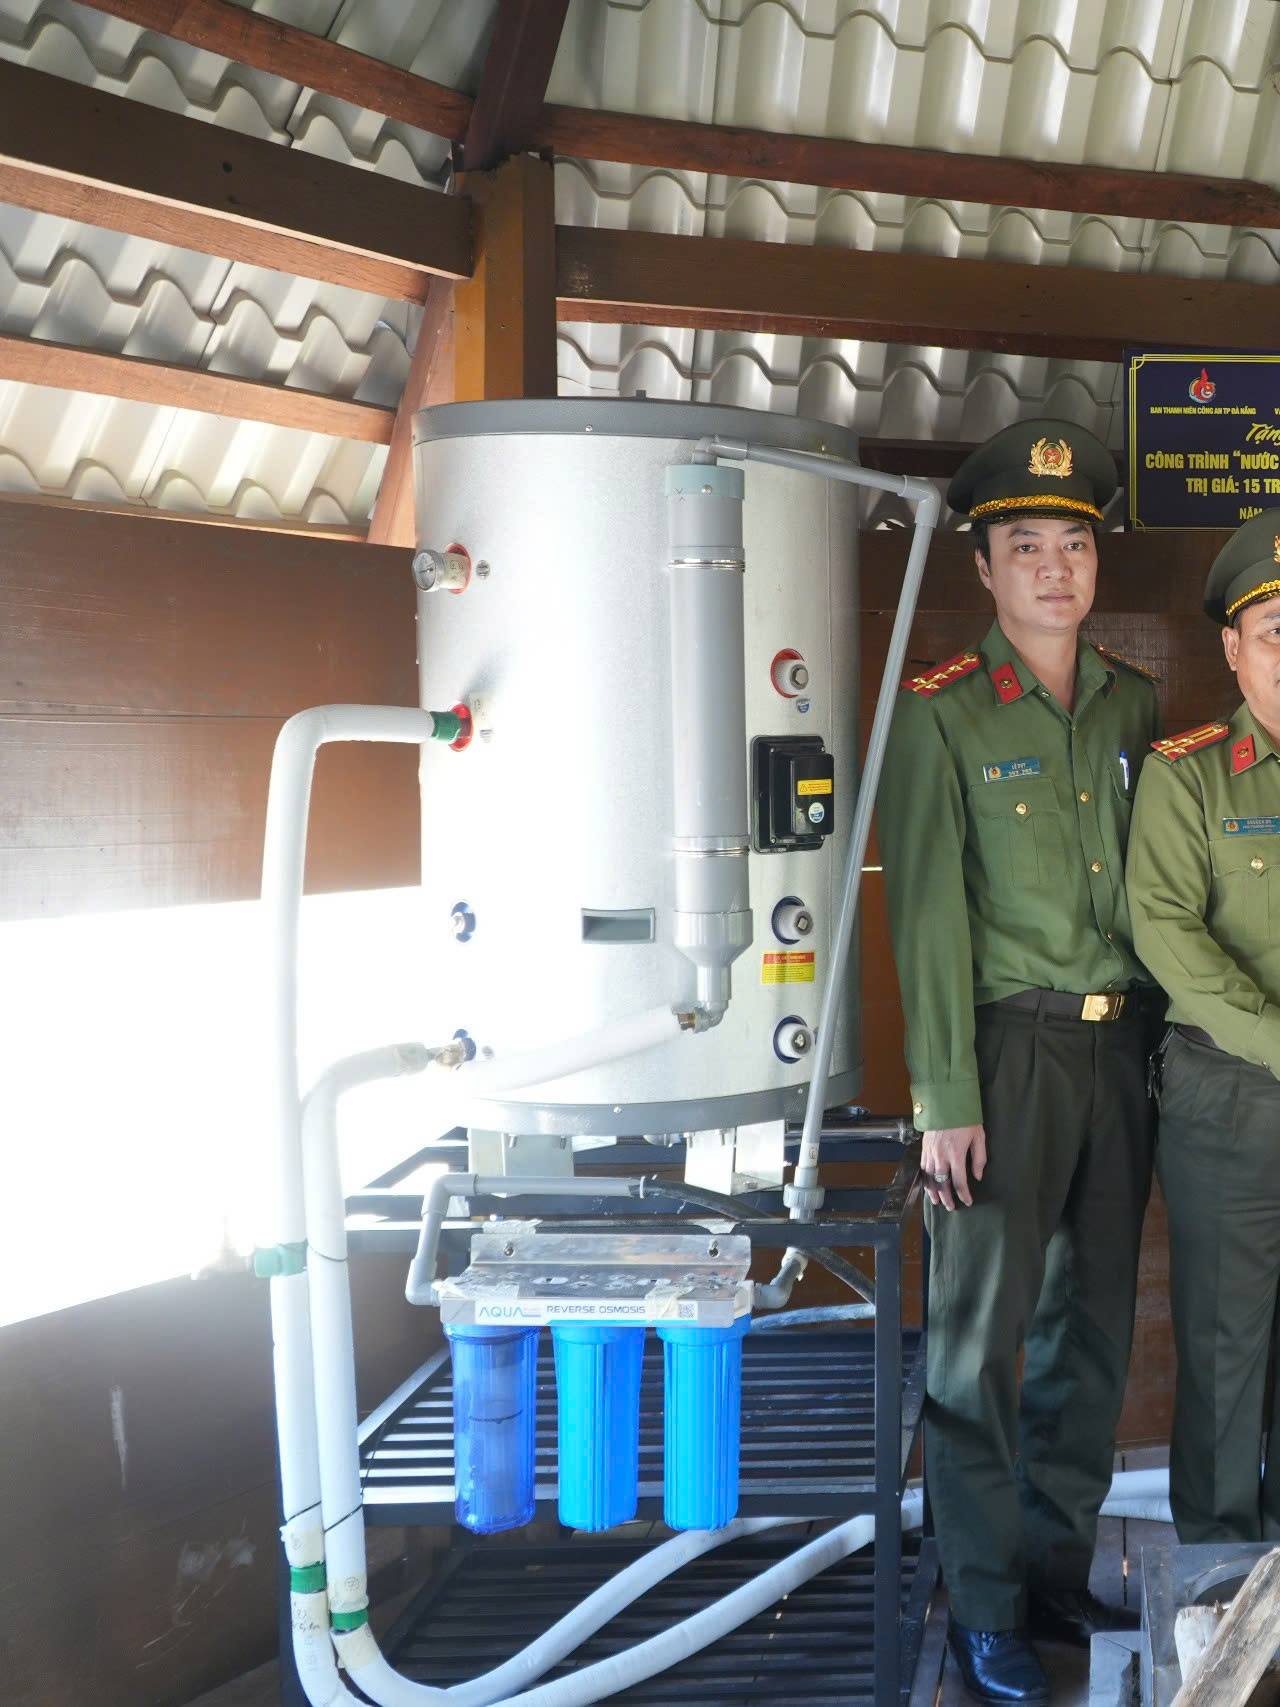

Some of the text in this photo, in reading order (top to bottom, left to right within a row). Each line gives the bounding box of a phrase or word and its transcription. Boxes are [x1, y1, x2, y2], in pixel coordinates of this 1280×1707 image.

[1150, 406, 1161, 414] BAN
[1197, 405, 1214, 414] CÔNG
[1145, 450, 1185, 469] CÔNG
[1187, 450, 1229, 469] TRÌNH
[1185, 478, 1208, 497] TRỊ
[1211, 475, 1240, 494] GIÁ:
[1242, 478, 1261, 494] 15
[479, 1306, 528, 1318] AQUA
[546, 1305, 596, 1313] REVERSE
[599, 1305, 646, 1314] OSMOSIS
